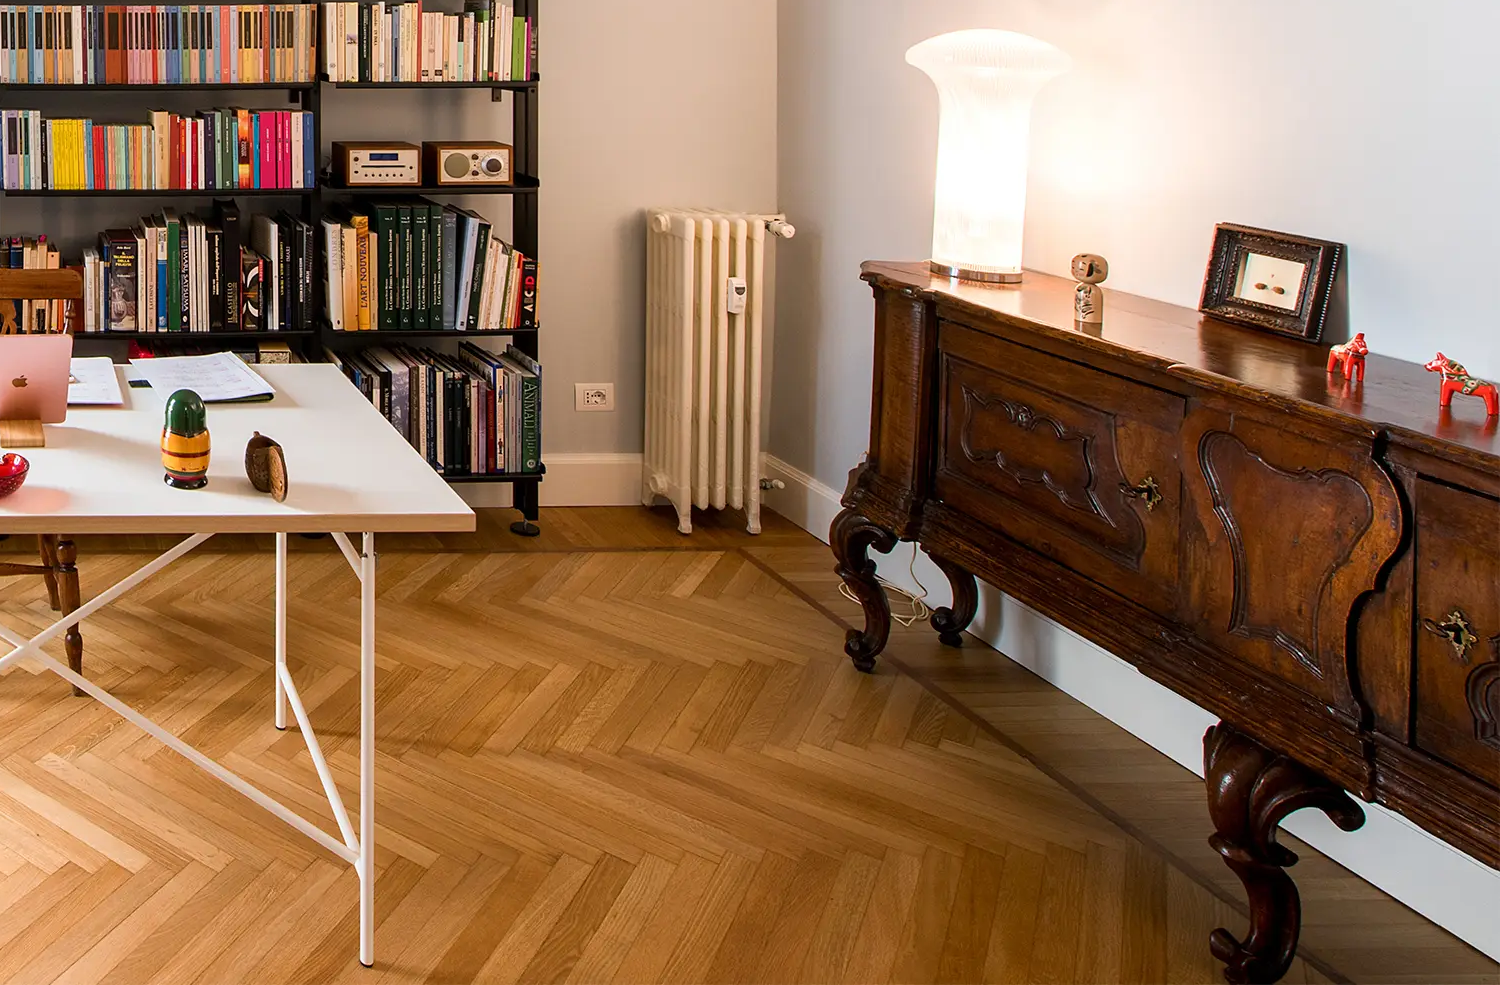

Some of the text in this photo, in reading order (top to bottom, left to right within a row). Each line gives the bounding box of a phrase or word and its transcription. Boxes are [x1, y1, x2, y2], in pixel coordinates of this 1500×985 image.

[331, 229, 339, 271] LONDRES
[359, 237, 368, 309] L'ART NOUVEAU
[524, 381, 538, 429] ANIMALI
